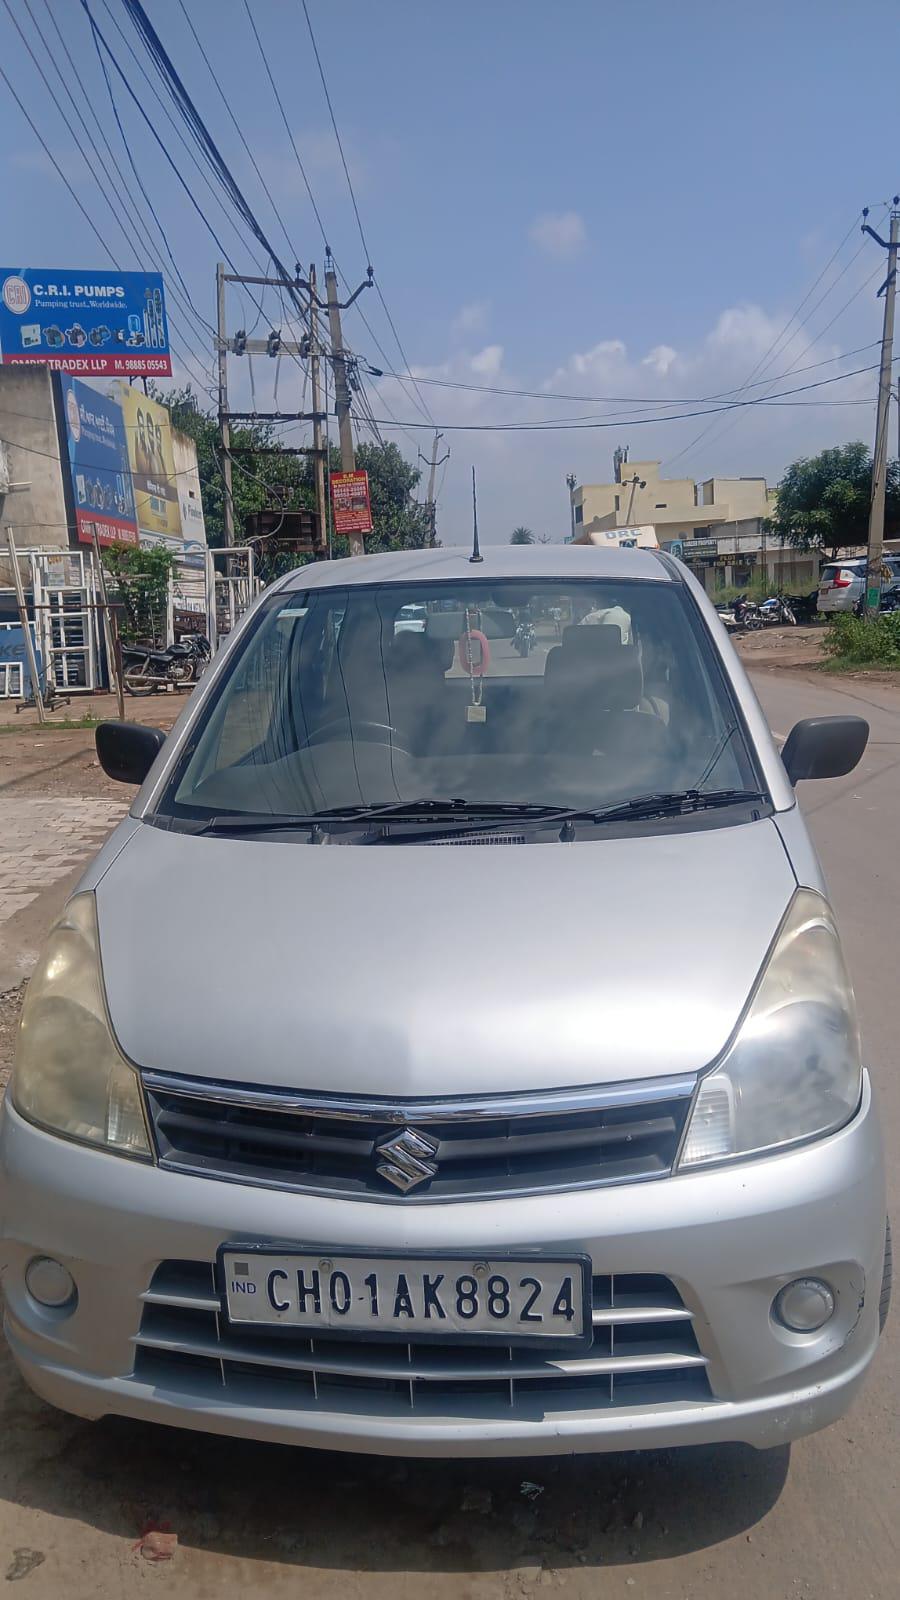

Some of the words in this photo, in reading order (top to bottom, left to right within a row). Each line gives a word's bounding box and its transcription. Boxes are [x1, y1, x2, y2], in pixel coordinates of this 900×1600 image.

[33, 284, 71, 296] C.R.I.
[74, 285, 125, 297] PUMPS
[35, 299, 68, 308] Pumping
[48, 359, 89, 370] TRADEX
[91, 359, 107, 370] LLP
[114, 360, 124, 369] M.
[231, 1281, 257, 1295] IND
[266, 1269, 575, 1322] CH01AK8824
